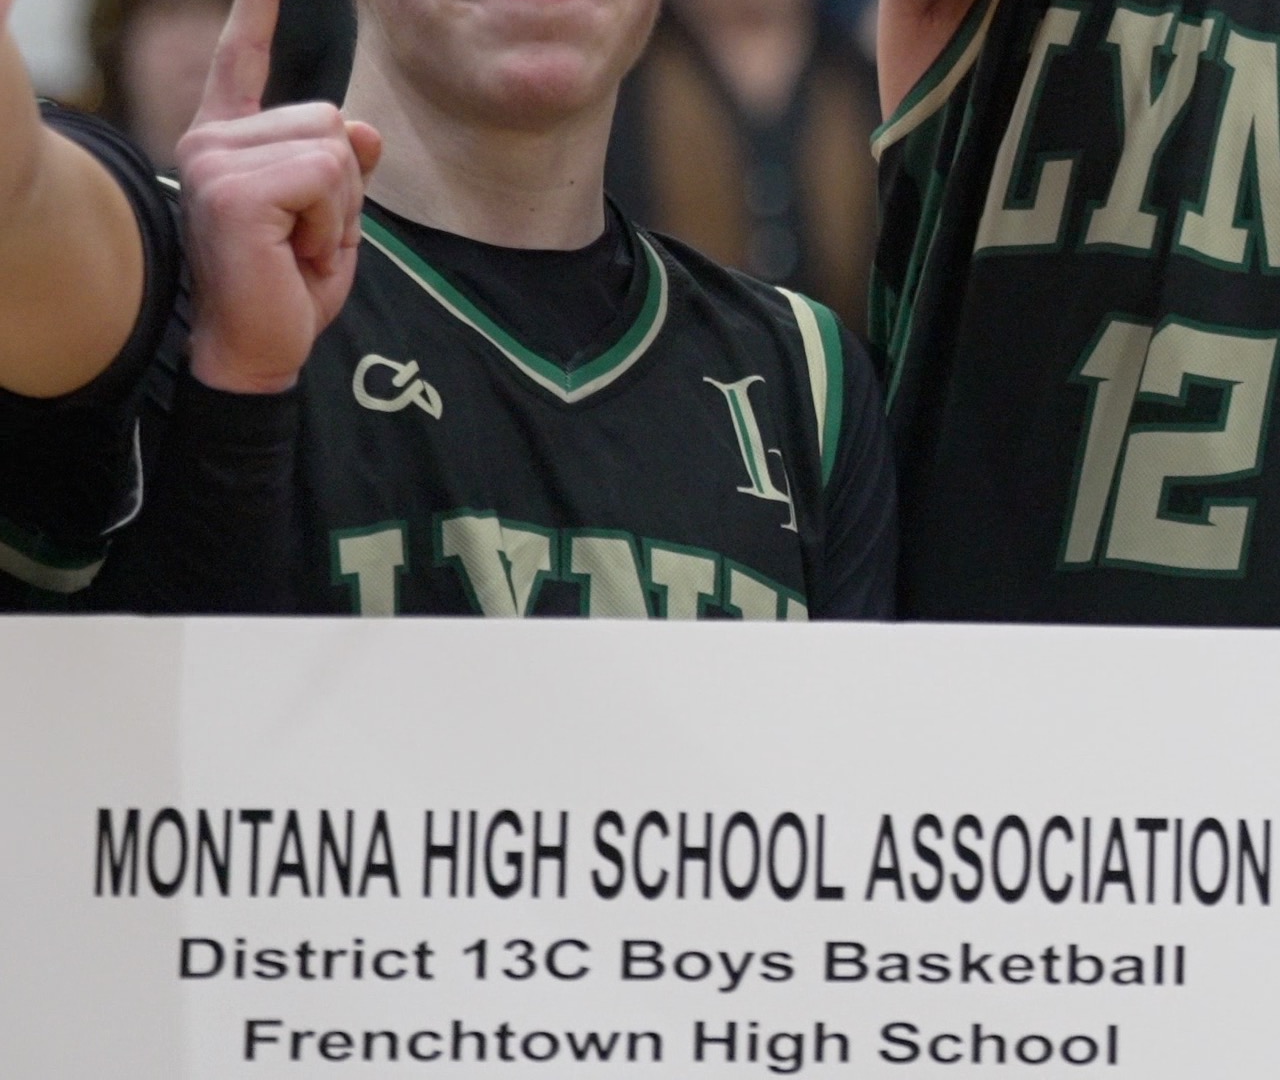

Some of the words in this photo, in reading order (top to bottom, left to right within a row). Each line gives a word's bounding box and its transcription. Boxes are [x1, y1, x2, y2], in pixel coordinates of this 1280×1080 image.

[94, 807, 400, 899] MONTANA
[423, 808, 569, 900] HIGH
[591, 809, 845, 902] SCHOOL
[864, 813, 1271, 906] ASSOCIATION
[179, 937, 434, 980] District
[463, 938, 590, 981] 13C
[621, 939, 794, 993] Boys
[824, 941, 1185, 986] Basketball
[244, 1019, 662, 1062] Frenchtown
[694, 1020, 849, 1075] High
[878, 1021, 1118, 1066] School
